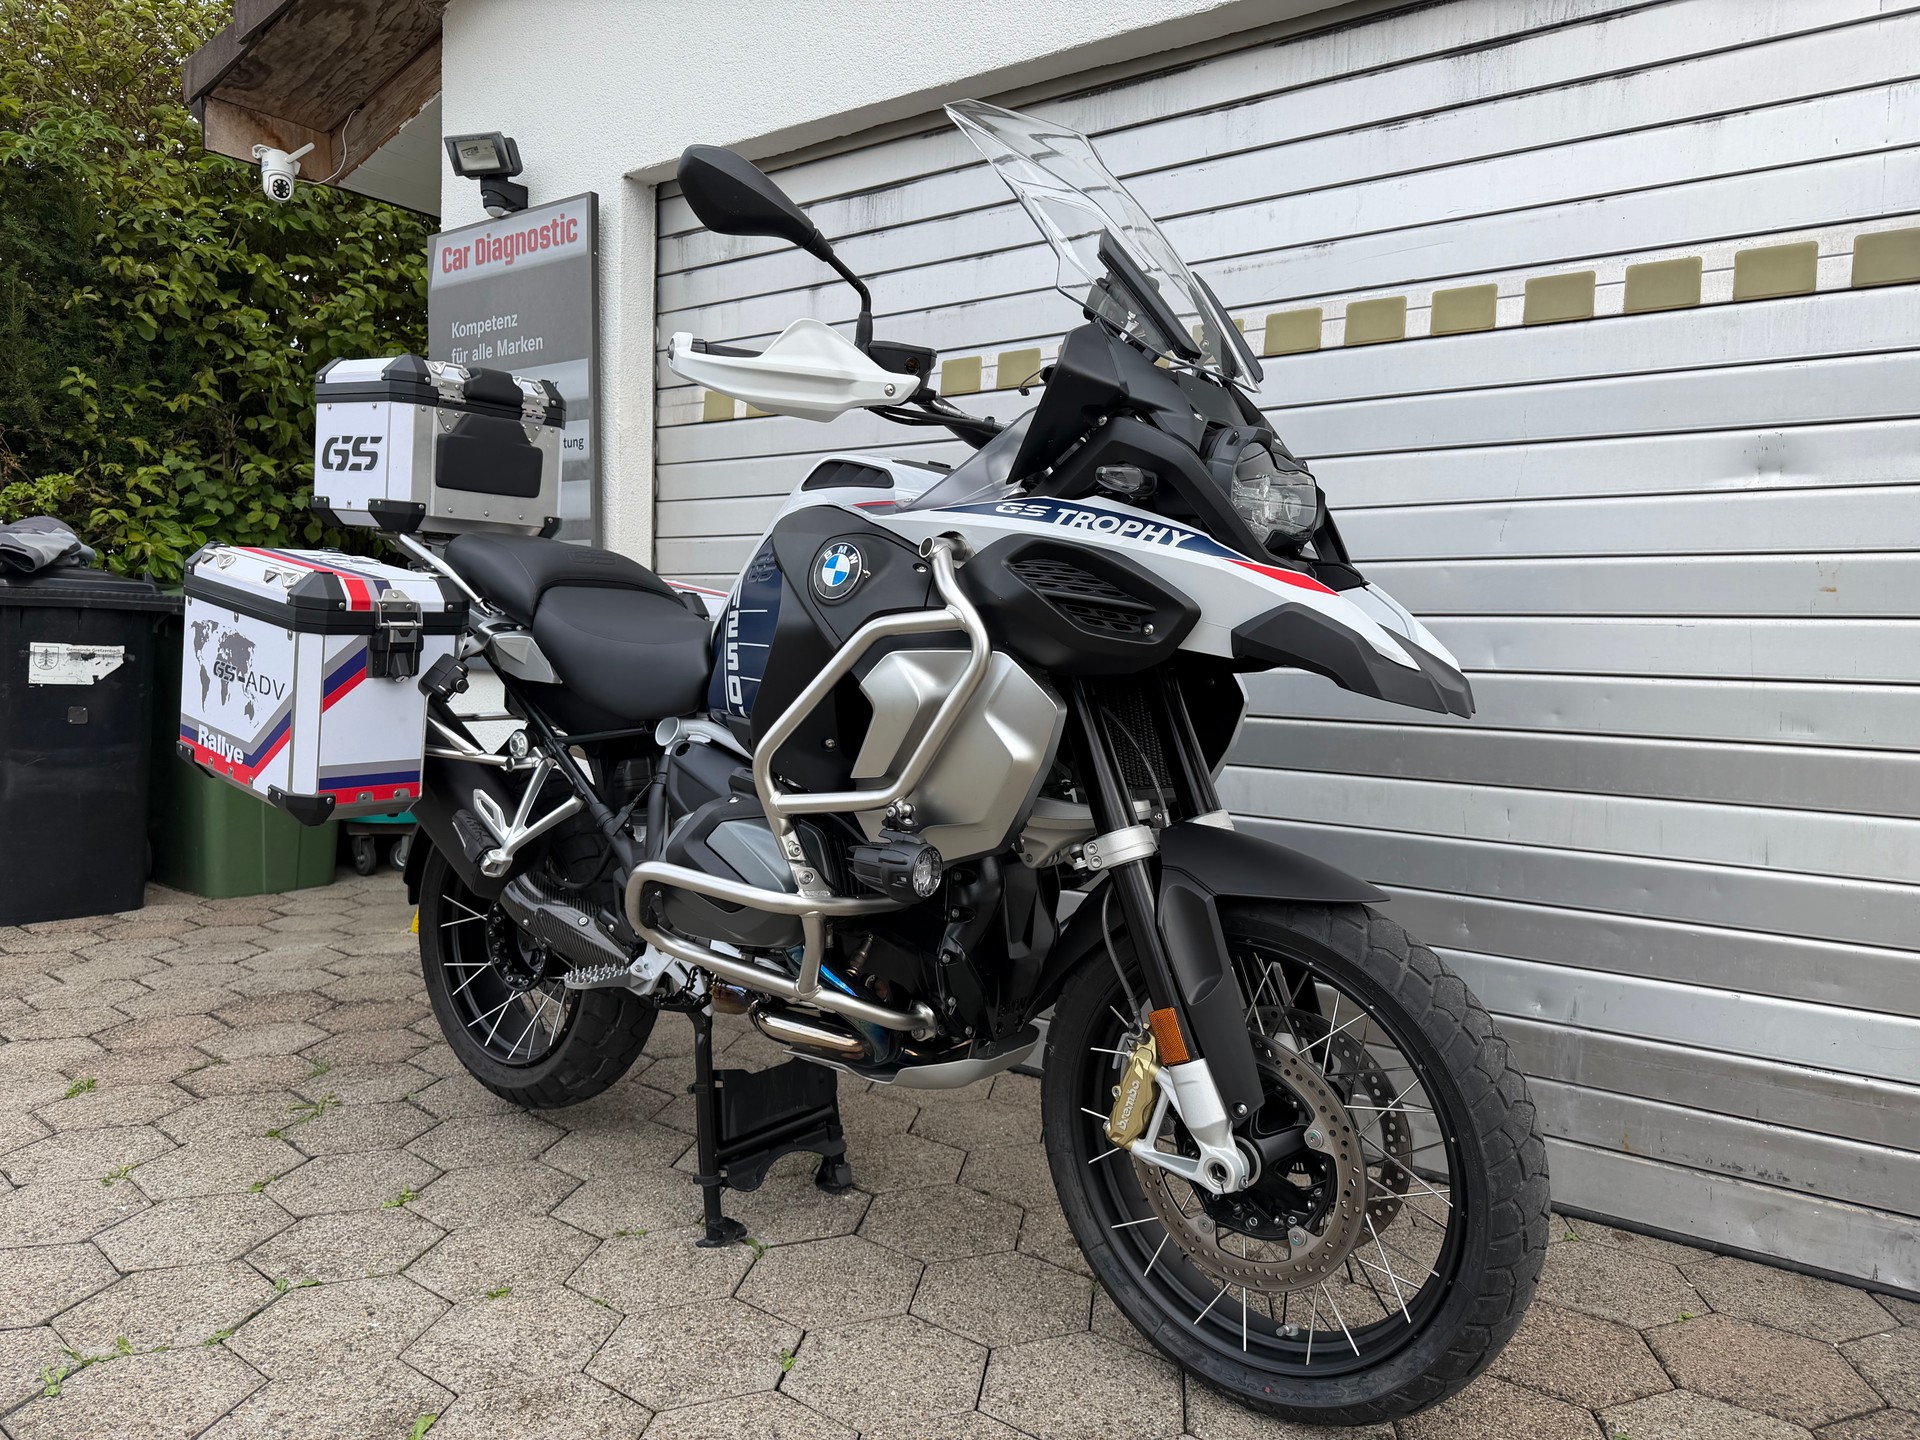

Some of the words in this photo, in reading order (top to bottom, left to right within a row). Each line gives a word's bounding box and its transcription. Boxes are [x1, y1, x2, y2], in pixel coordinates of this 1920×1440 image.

[442, 246, 470, 273] Car
[475, 213, 578, 265] Diagnostic
[451, 313, 518, 339] Kompetenz
[451, 347, 468, 364] für
[472, 343, 493, 361] alle
[497, 335, 544, 357] Marken
[321, 435, 383, 472] GS
[995, 502, 1052, 517] GS
[1053, 508, 1196, 548] TROPHY
[824, 545, 859, 565] BMW
[213, 660, 286, 701] GS-ADV
[198, 723, 244, 765] Rallye
[1117, 1079, 1141, 1131] brembo
